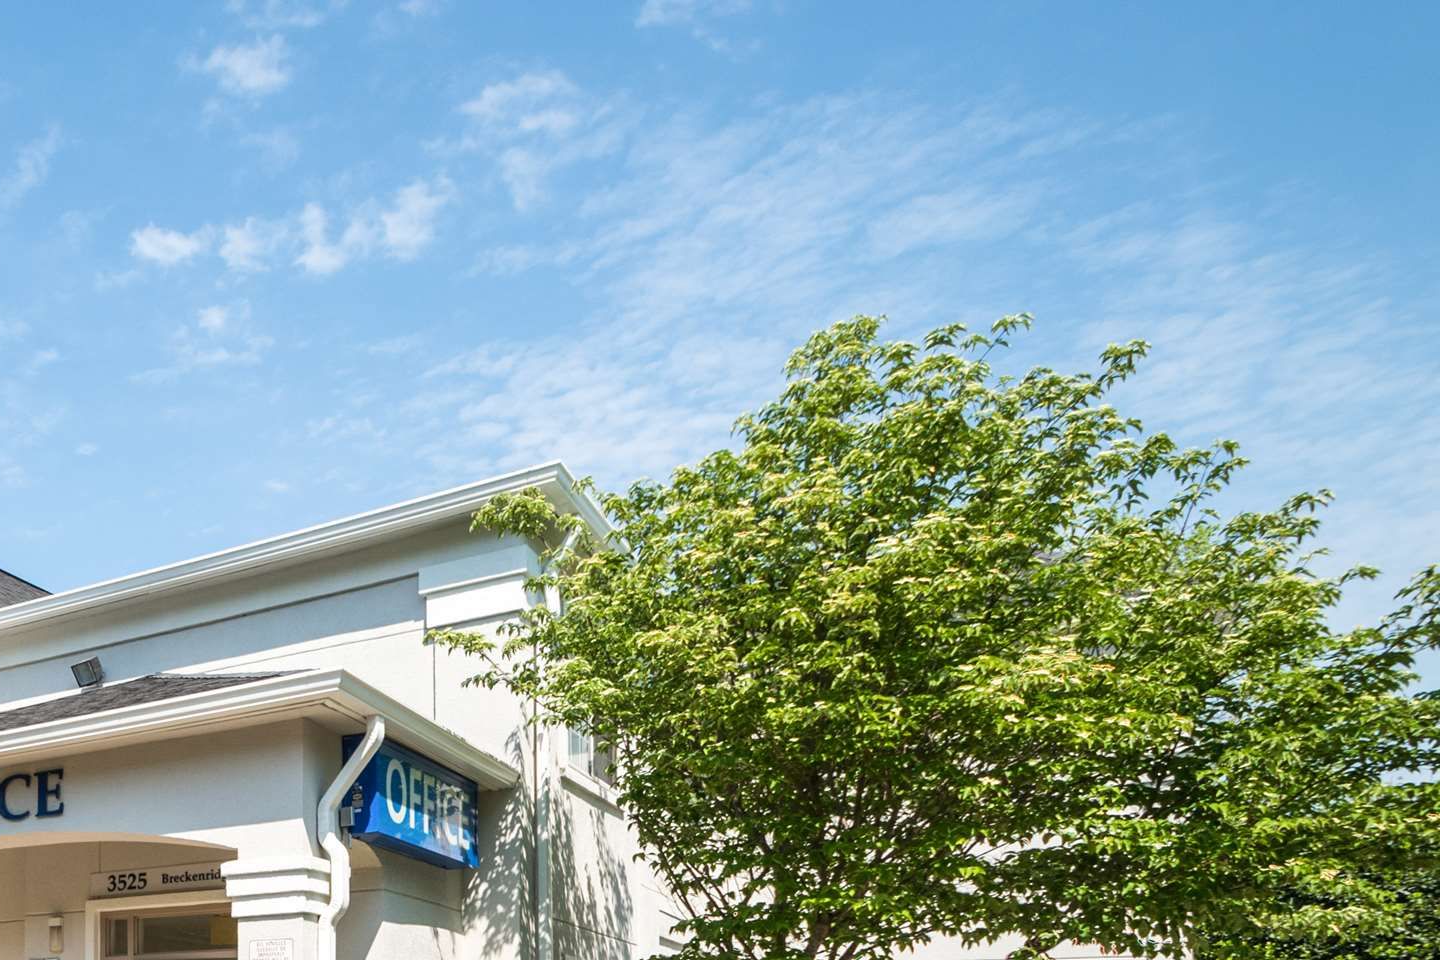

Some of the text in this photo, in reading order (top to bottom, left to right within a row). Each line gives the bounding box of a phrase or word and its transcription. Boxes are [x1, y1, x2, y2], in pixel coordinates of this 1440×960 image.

[386, 759, 470, 850] OFFICE
[107, 869, 226, 892] 3525 Breckenrid
